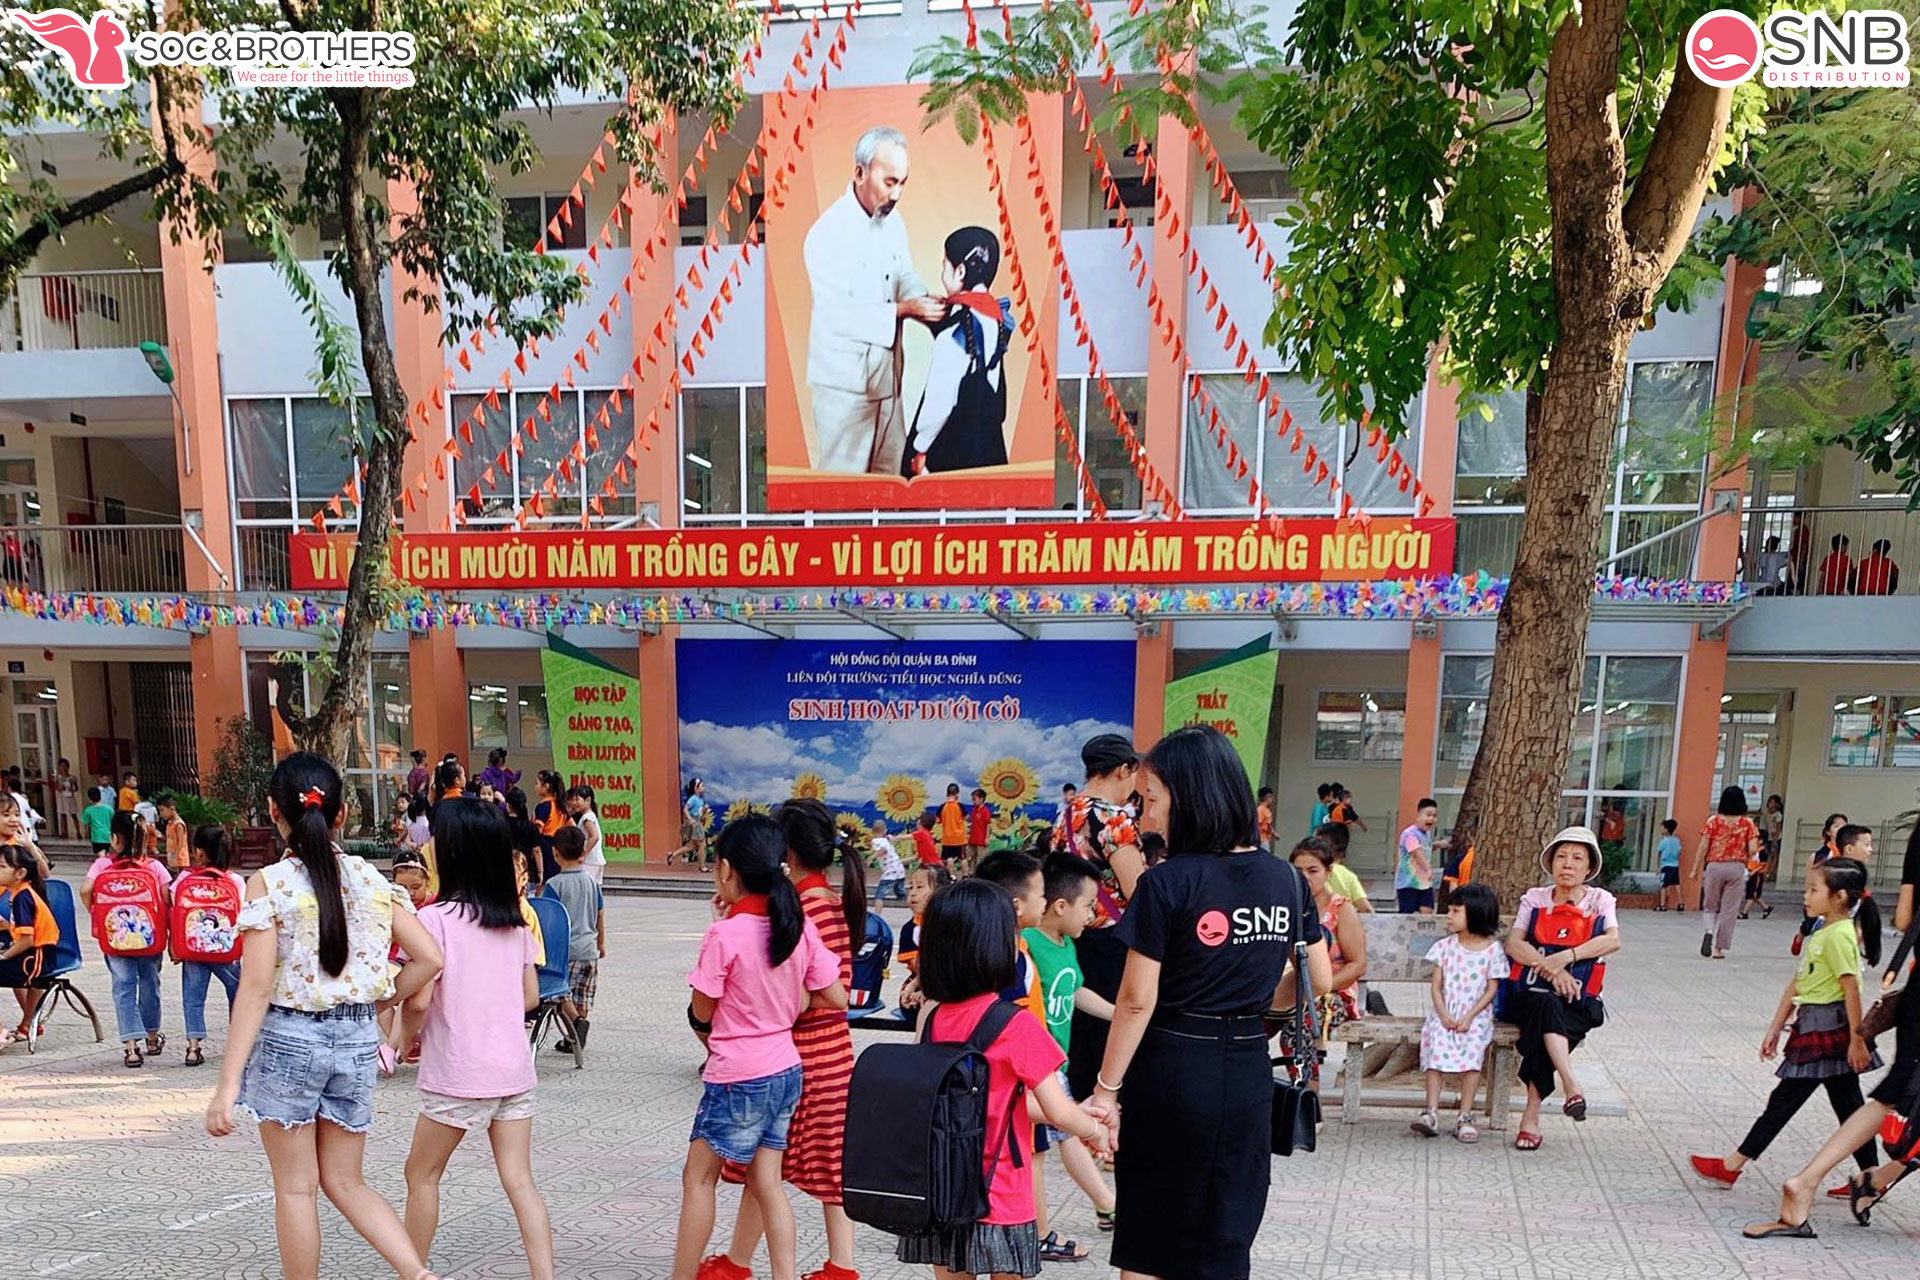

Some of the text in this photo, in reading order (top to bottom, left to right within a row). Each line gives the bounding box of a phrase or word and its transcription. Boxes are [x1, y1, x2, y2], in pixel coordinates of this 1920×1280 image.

[309, 541, 337, 580] VÌ
[401, 540, 450, 579] ÍCH
[460, 538, 537, 579] MƯỜI
[547, 537, 617, 578] NĂM
[626, 532, 728, 578] TRỒNG
[738, 535, 800, 577] CÂY
[832, 534, 862, 576] VÌ
[872, 537, 922, 583] LỢI
[934, 533, 988, 575] ÍCH
[998, 530, 1092, 574] TRĂM
[1103, 529, 1183, 573] NĂM
[1194, 523, 1309, 572] TRỒNG
[1320, 523, 1432, 571] NGƯỜI
[830, 651, 849, 668] HỘI
[902, 651, 932, 668] QUẬN
[934, 654, 949, 666] BA
[920, 673, 946, 687] HỌC
[789, 694, 1021, 724] SINH HOẠT DƯỚI CỜ
[1232, 905, 1290, 936] SNB
